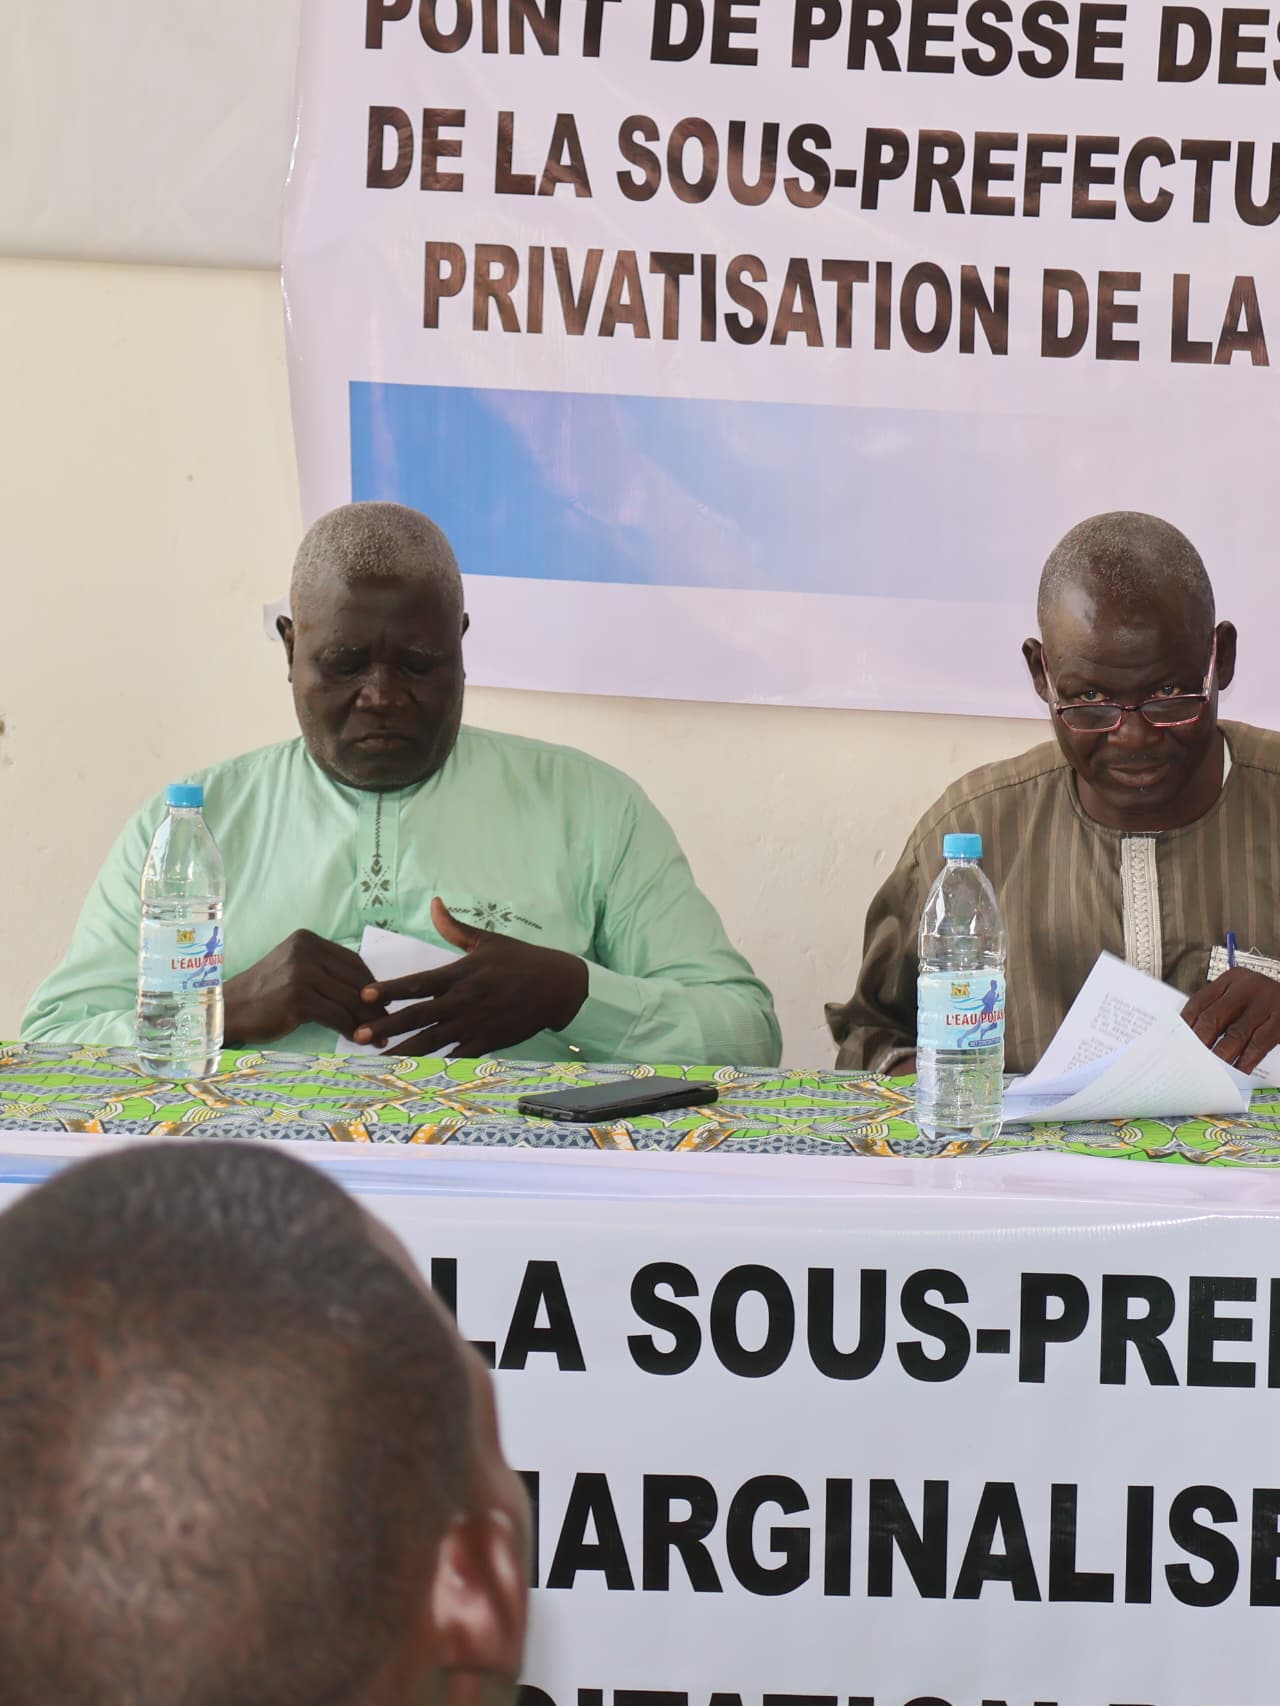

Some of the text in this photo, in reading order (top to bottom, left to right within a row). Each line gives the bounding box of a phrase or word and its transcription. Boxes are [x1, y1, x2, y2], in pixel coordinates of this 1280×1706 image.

[365, 0, 621, 57] POINT
[650, 0, 760, 66] DE
[792, 0, 1127, 81] PRESSE
[366, 105, 466, 192] DE
[495, 111, 593, 198] LA
[424, 242, 1010, 355] PRIVATISATION
[1041, 269, 1141, 361] DE
[1171, 274, 1269, 366] LA
